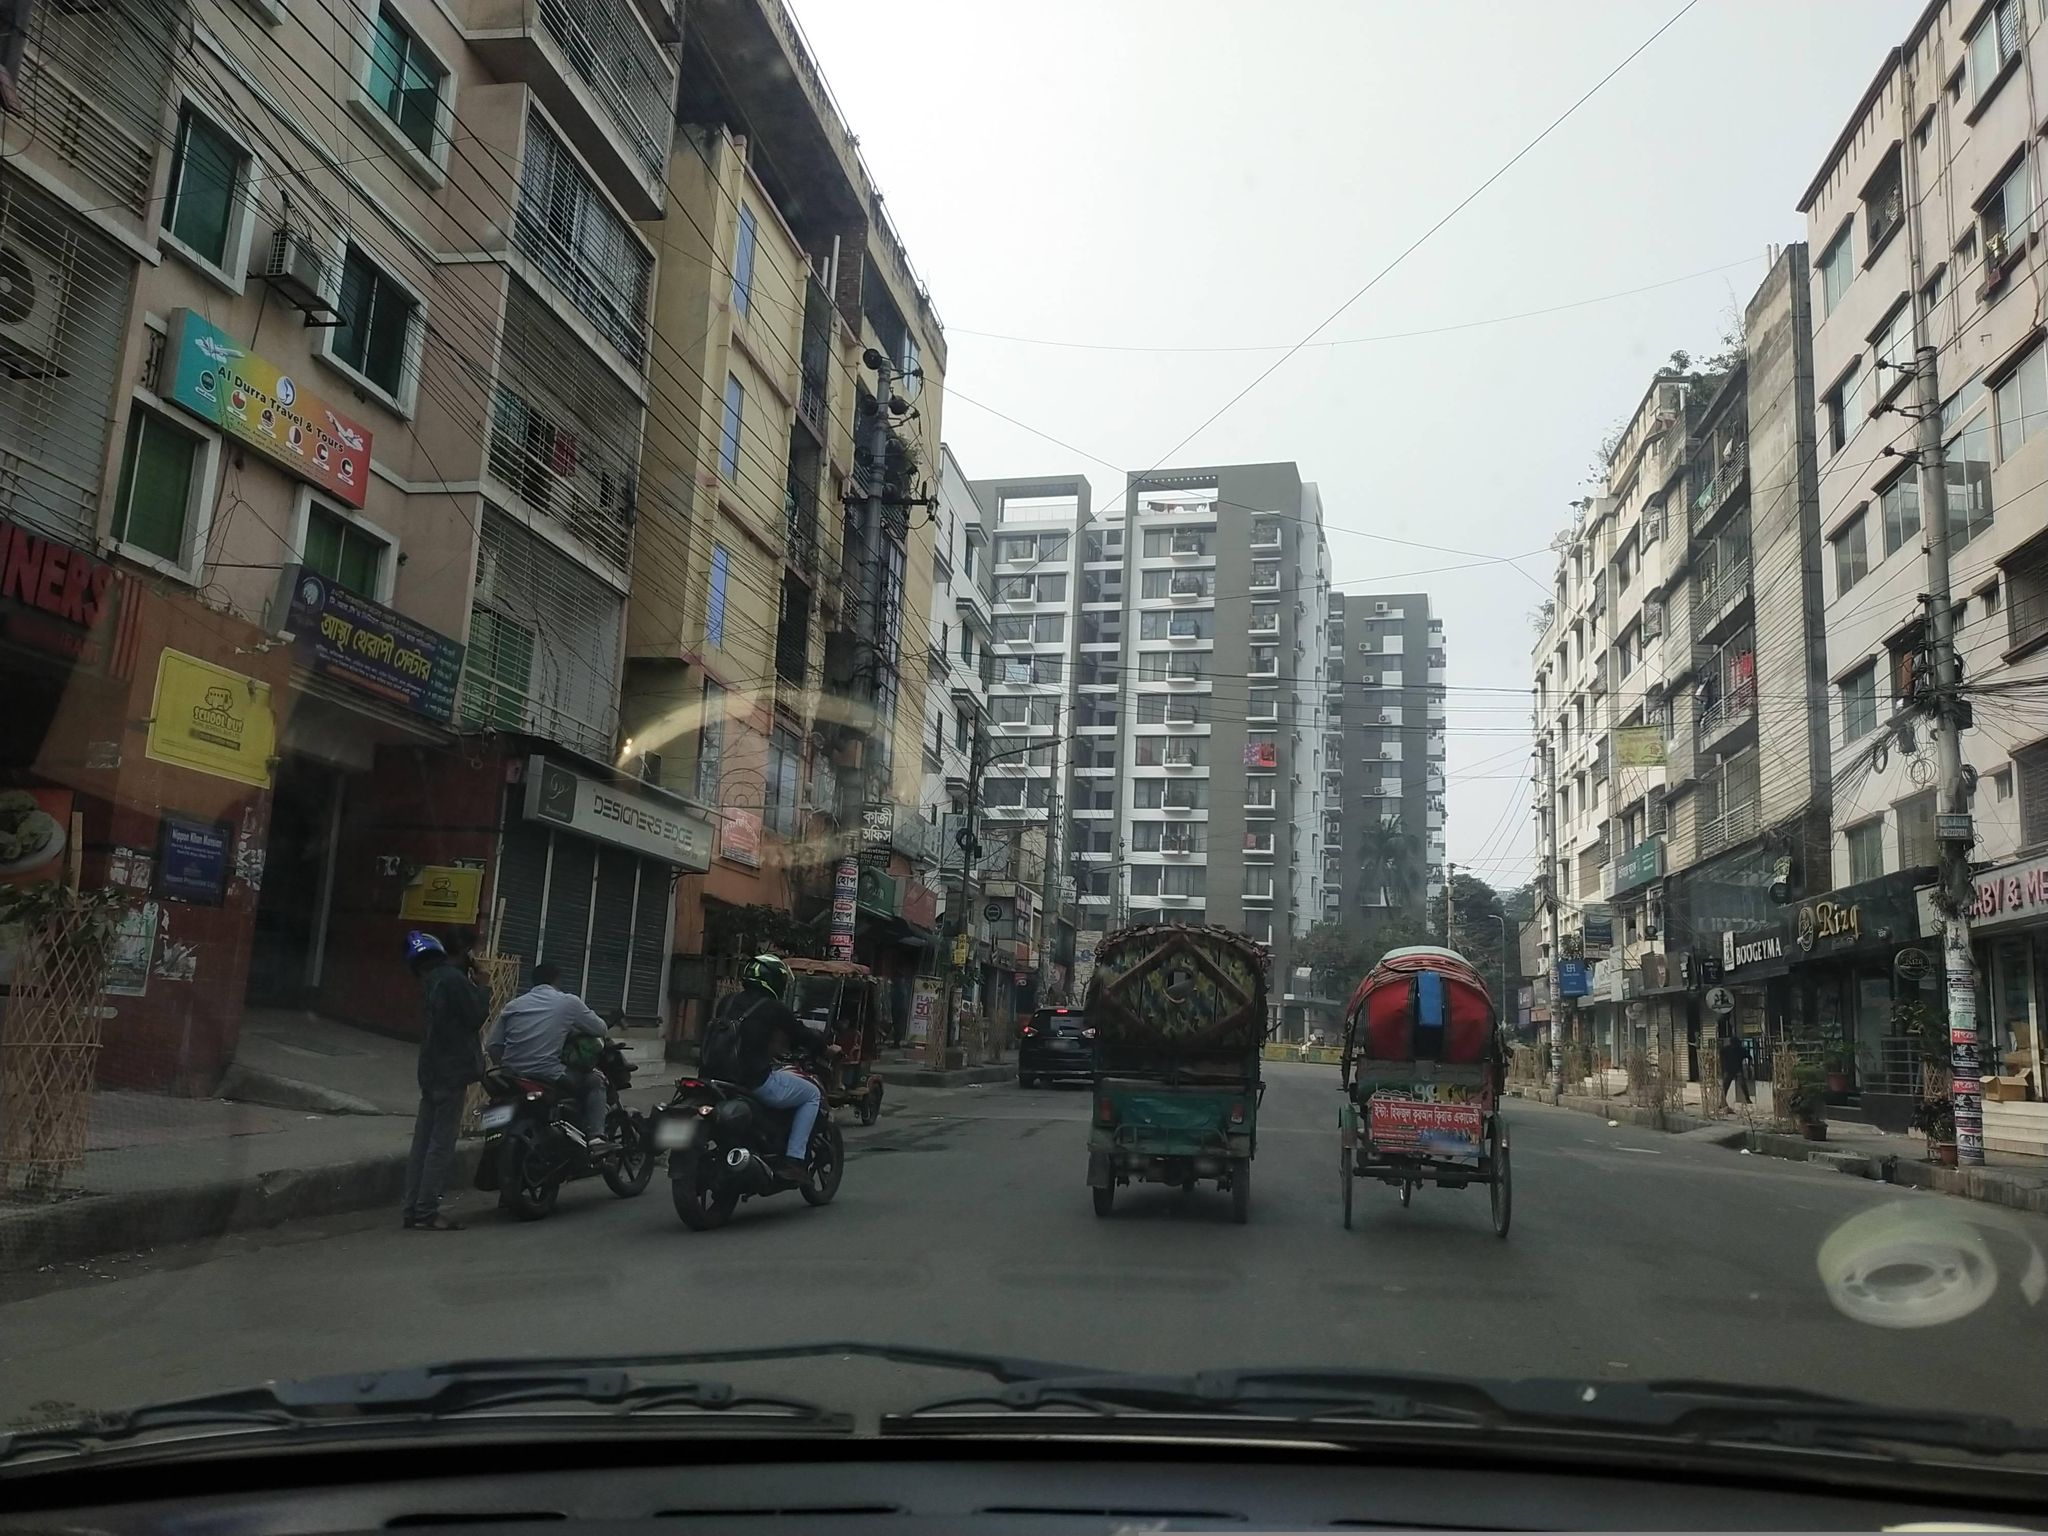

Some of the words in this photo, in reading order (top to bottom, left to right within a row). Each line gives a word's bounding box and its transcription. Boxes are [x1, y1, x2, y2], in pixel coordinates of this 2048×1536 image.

[218, 366, 232, 381] Al
[234, 375, 268, 404] Durra
[269, 397, 304, 427] Travel
[305, 422, 313, 433] &
[316, 427, 345, 453] Tours
[593, 794, 662, 835] DESIGNERS
[663, 822, 693, 846] EDGE
[862, 808, 893, 827] কাজী
[862, 825, 892, 843] অফিস
[2007, 877, 2020, 907] &
[1816, 901, 1862, 940] Rizq
[1735, 937, 1782, 966] BOOGEYMA
